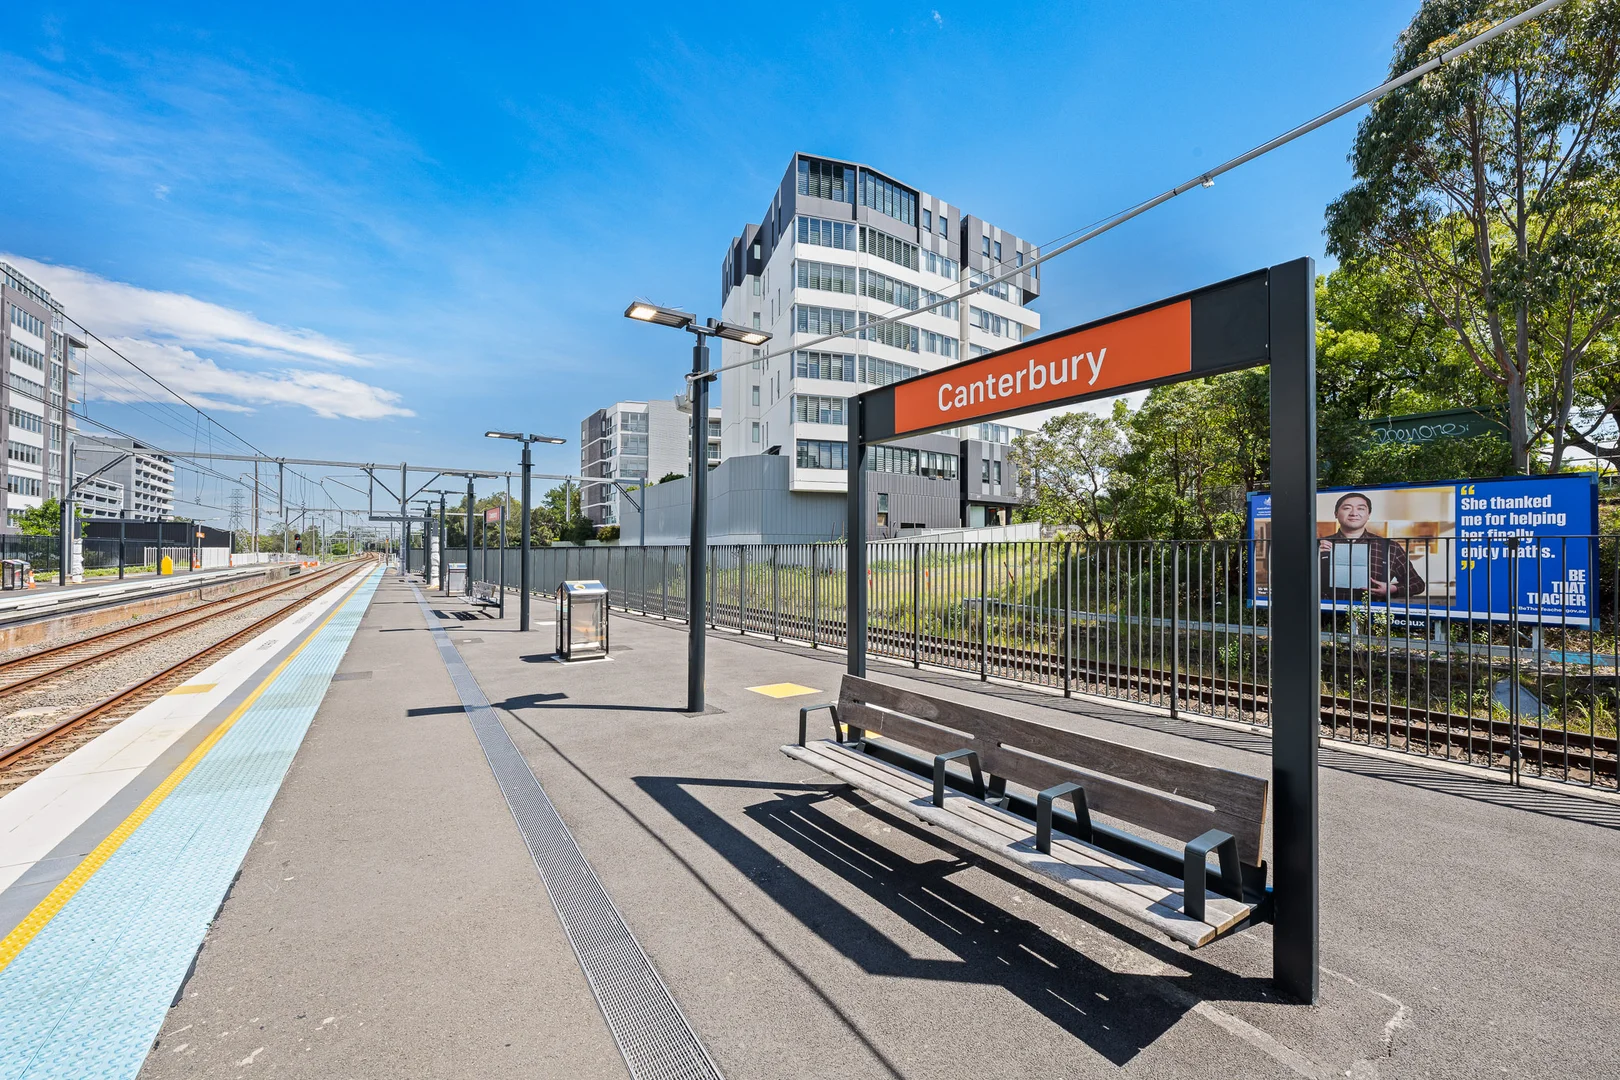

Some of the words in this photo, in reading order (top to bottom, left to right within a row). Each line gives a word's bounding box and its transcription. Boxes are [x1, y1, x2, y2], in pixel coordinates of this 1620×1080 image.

[938, 347, 1107, 412] Canterbury
[1461, 497, 1487, 510] She
[1490, 494, 1552, 510] thanked
[1461, 515, 1482, 526] me
[1485, 513, 1506, 526] for
[1509, 511, 1567, 527] helping
[1461, 529, 1484, 542] her
[1487, 528, 1534, 543] finally
[1461, 545, 1499, 560] enjoy
[1568, 569, 1586, 582] BE
[1551, 581, 1586, 594] THAT
